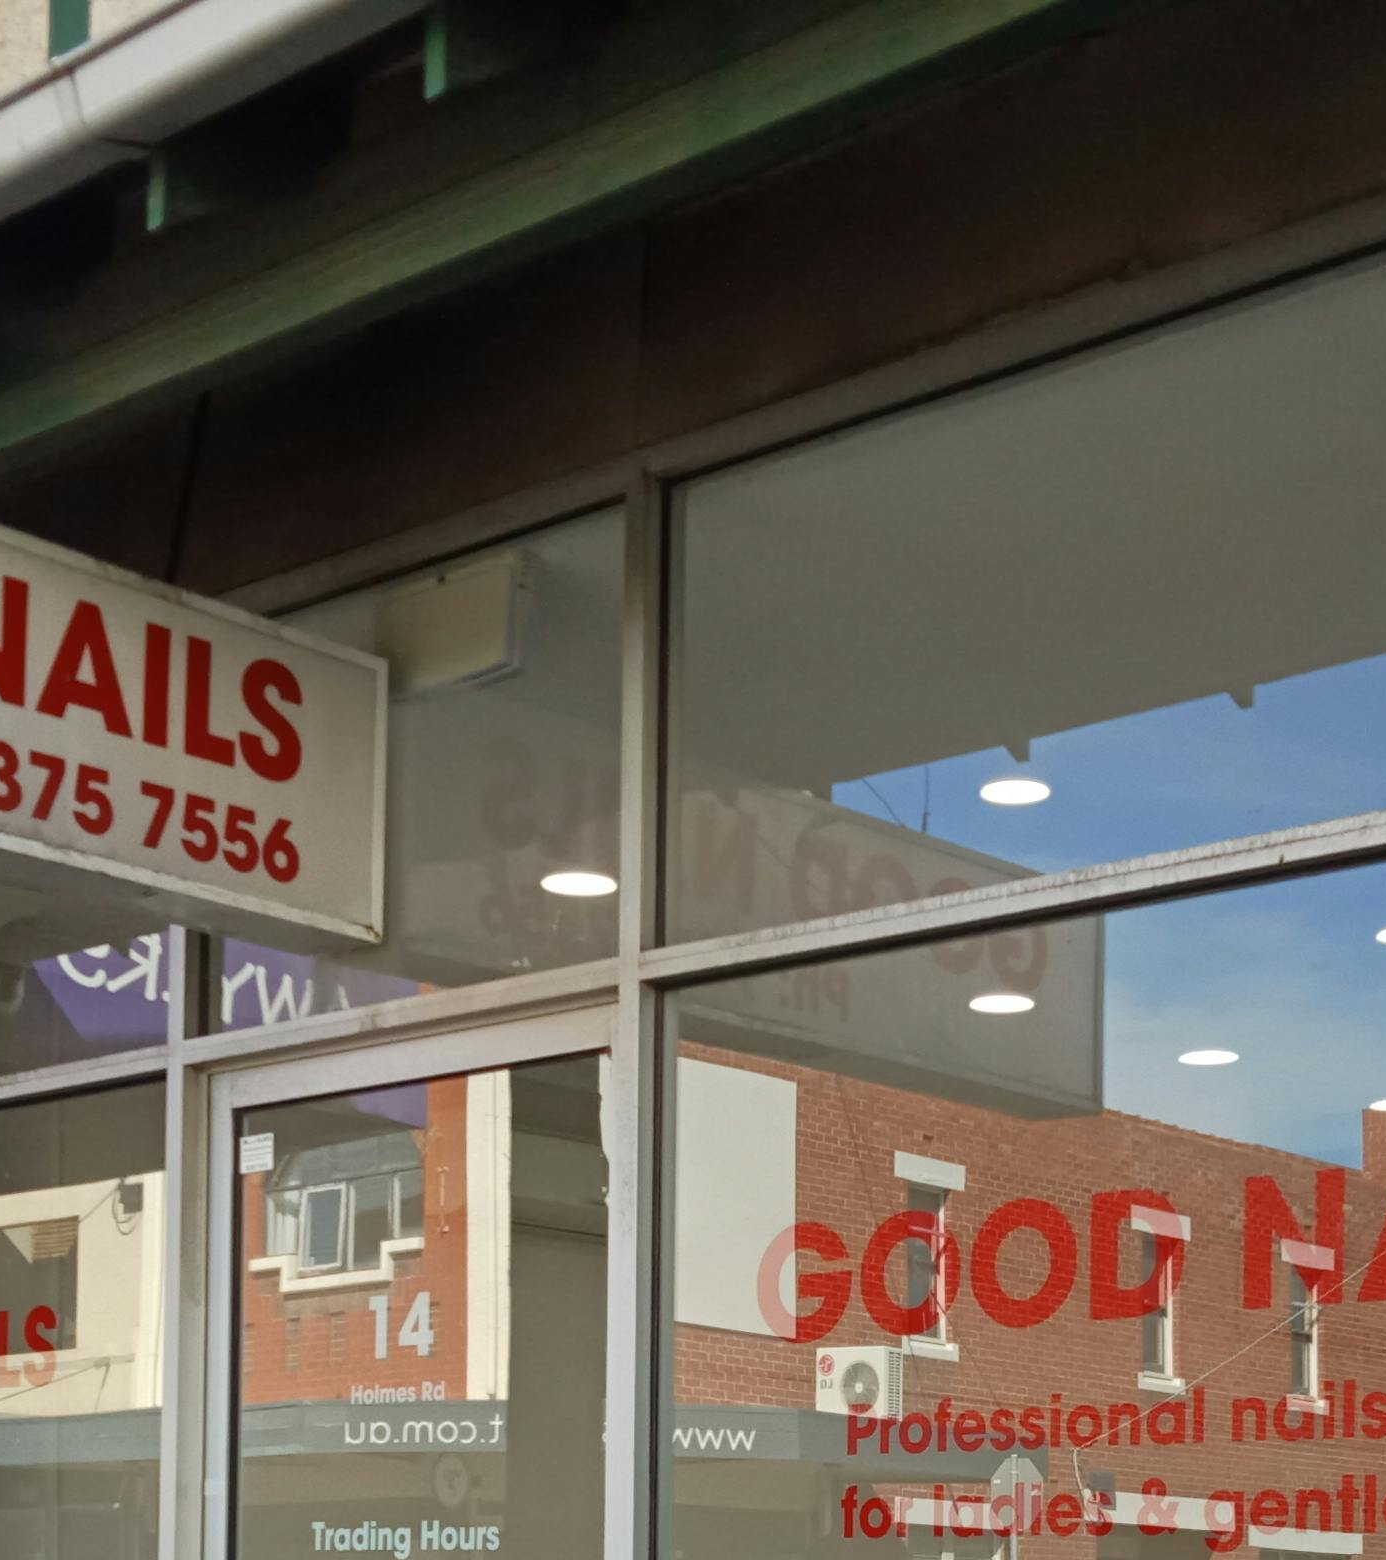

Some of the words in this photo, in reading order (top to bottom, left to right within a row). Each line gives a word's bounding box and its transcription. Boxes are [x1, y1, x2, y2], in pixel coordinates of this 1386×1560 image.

[139, 782, 301, 884] 7556
[756, 1187, 1185, 1343] GOOD
[368, 1291, 435, 1360] 14
[349, 1384, 416, 1406] Holmes
[421, 1380, 446, 1402] Rd
[846, 1389, 1205, 1456] Professional
[312, 1521, 412, 1560] Trading
[420, 1519, 500, 1552] Hours
[842, 1483, 909, 1540] for
[934, 1481, 1113, 1542] ladies
[1136, 1478, 1181, 1534] &
